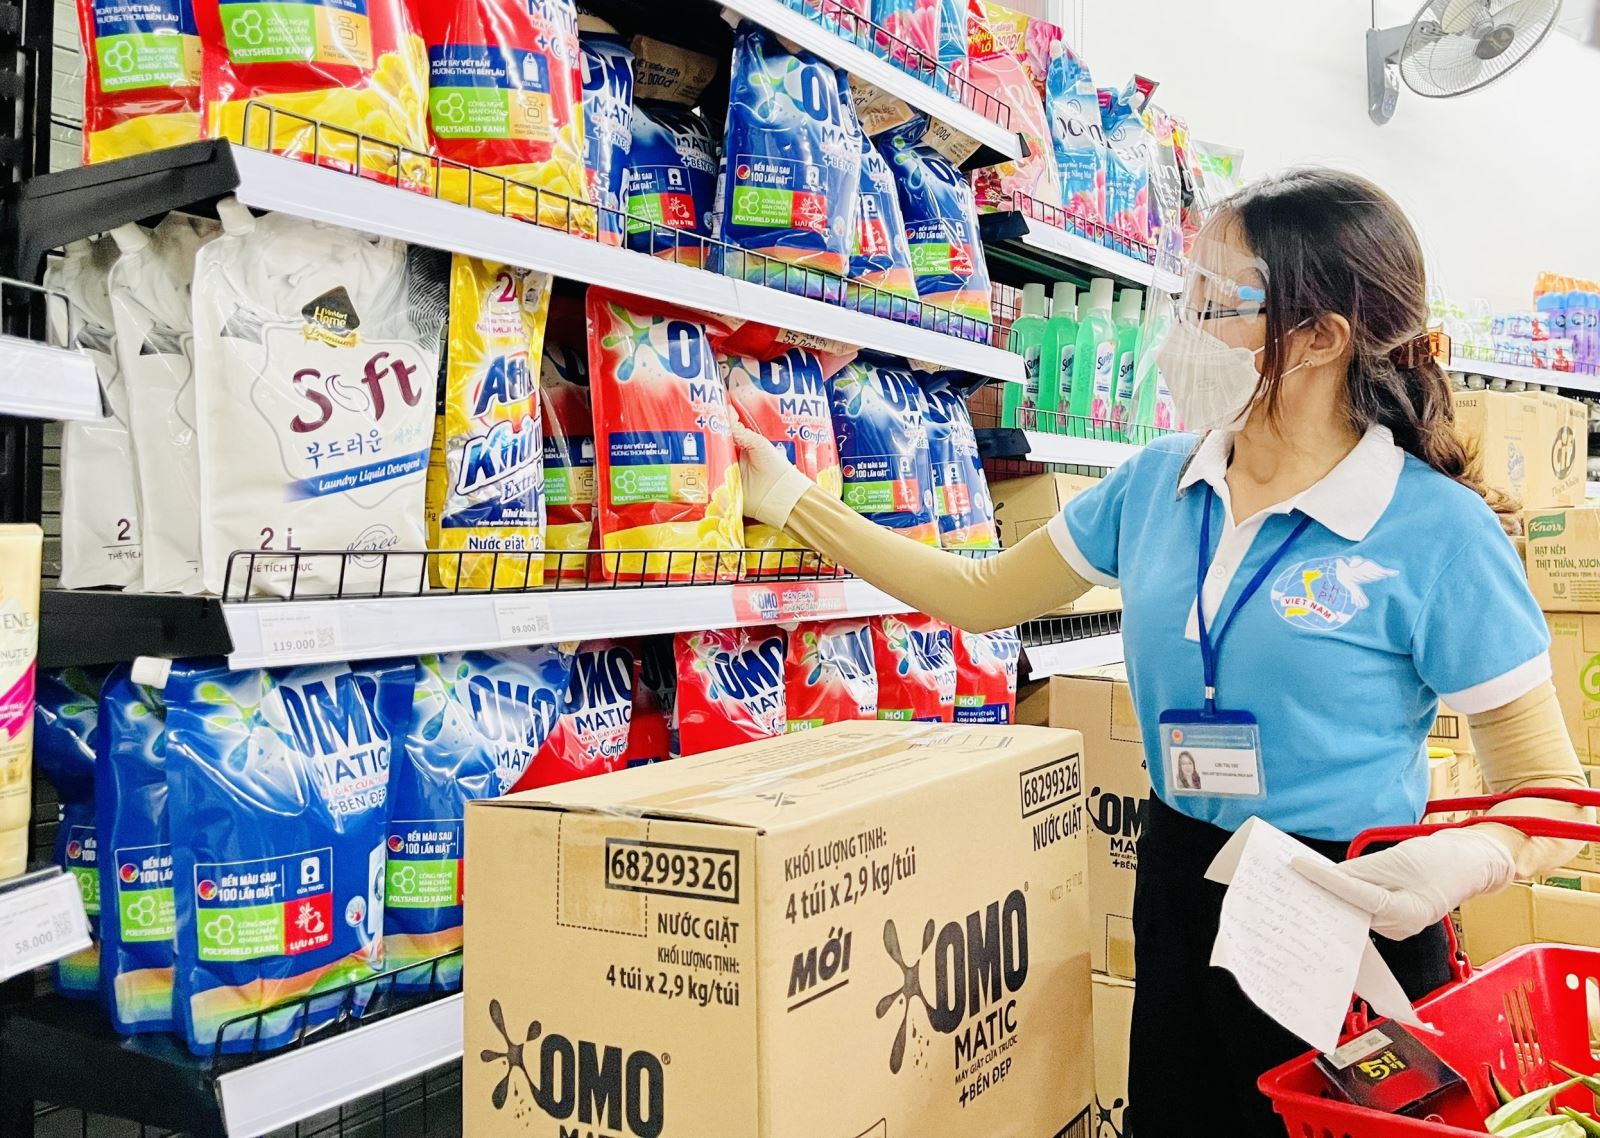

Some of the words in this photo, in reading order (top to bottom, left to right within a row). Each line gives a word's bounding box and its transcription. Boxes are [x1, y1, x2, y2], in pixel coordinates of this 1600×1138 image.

[233, 46, 284, 57] POLYSHIELD
[436, 126, 481, 134] POLYSHIELD
[482, 126, 506, 134] XANH
[750, 172, 764, 182] 100
[779, 166, 790, 175] SAU
[735, 214, 769, 224] POLYSHIELD
[314, 306, 346, 328] Home
[290, 352, 422, 433] Soft
[305, 429, 383, 470] 부드러운
[319, 474, 358, 491] Laundry
[359, 467, 386, 483] Liquid
[387, 458, 420, 476] Detergent
[856, 470, 867, 478] 100
[117, 518, 131, 541] 2
[1530, 520, 1564, 532] Knorr
[260, 527, 274, 551] 2
[469, 536, 501, 550] Nước
[1534, 546, 1548, 557] HẠT
[264, 561, 288, 573] TÍCH
[1536, 560, 1551, 570] THỊT
[758, 592, 778, 610] OMO
[762, 610, 780, 620] MATIC
[1310, 602, 1332, 620] NAM
[272, 638, 316, 652] 119.000
[511, 624, 537, 635] 89.000
[575, 704, 632, 735] MATIC
[884, 709, 906, 720] MỚI
[1024, 762, 1078, 808] 68299326
[408, 830, 420, 842] BỀN
[422, 830, 437, 842] MÀU
[438, 832, 452, 841] SAU
[1032, 814, 1061, 852] NƯỚC
[1062, 803, 1082, 839] GIẶT
[82, 850, 96, 861] 100
[405, 842, 420, 854] 100
[420, 842, 434, 854] LẦN
[784, 844, 816, 882] KHỐI
[817, 840, 856, 870] LƯỢNG
[859, 826, 888, 860] TỊNH:
[142, 856, 158, 869] BỀN
[611, 848, 733, 892] 68299326
[140, 870, 158, 884] 100
[222, 874, 238, 887] BỀN
[240, 872, 258, 886] MÀU
[260, 872, 277, 884] SAU
[785, 894, 797, 924] 4
[800, 880, 826, 920] túi
[830, 884, 840, 910] x
[844, 867, 868, 904] 2,9
[872, 846, 916, 896] kg/túi
[218, 888, 237, 902] 100
[238, 886, 255, 900] LẦN
[388, 895, 430, 903] POLYSHIELD
[657, 912, 700, 939] NƯỚC
[704, 916, 740, 948] GIẶT
[15, 930, 54, 955] 58.000
[203, 947, 252, 955] POLYSHIELD
[253, 944, 279, 954] XANH
[290, 942, 306, 952] LỰU
[314, 934, 328, 944] TRE
[657, 944, 680, 965] KHỐI
[681, 950, 712, 972] LƯỢNG
[714, 955, 740, 976] TỊNH:
[787, 926, 852, 998] MỚI
[934, 889, 1028, 1034] OMO
[606, 964, 616, 986] 4
[620, 966, 642, 991] túi
[645, 974, 655, 992] x
[658, 972, 684, 1000] 2,9
[688, 975, 740, 1007] kg/túi
[955, 999, 1018, 1070] MATIC
[992, 1057, 1012, 1084] ĐẸP
[540, 1034, 664, 1138] OMO
